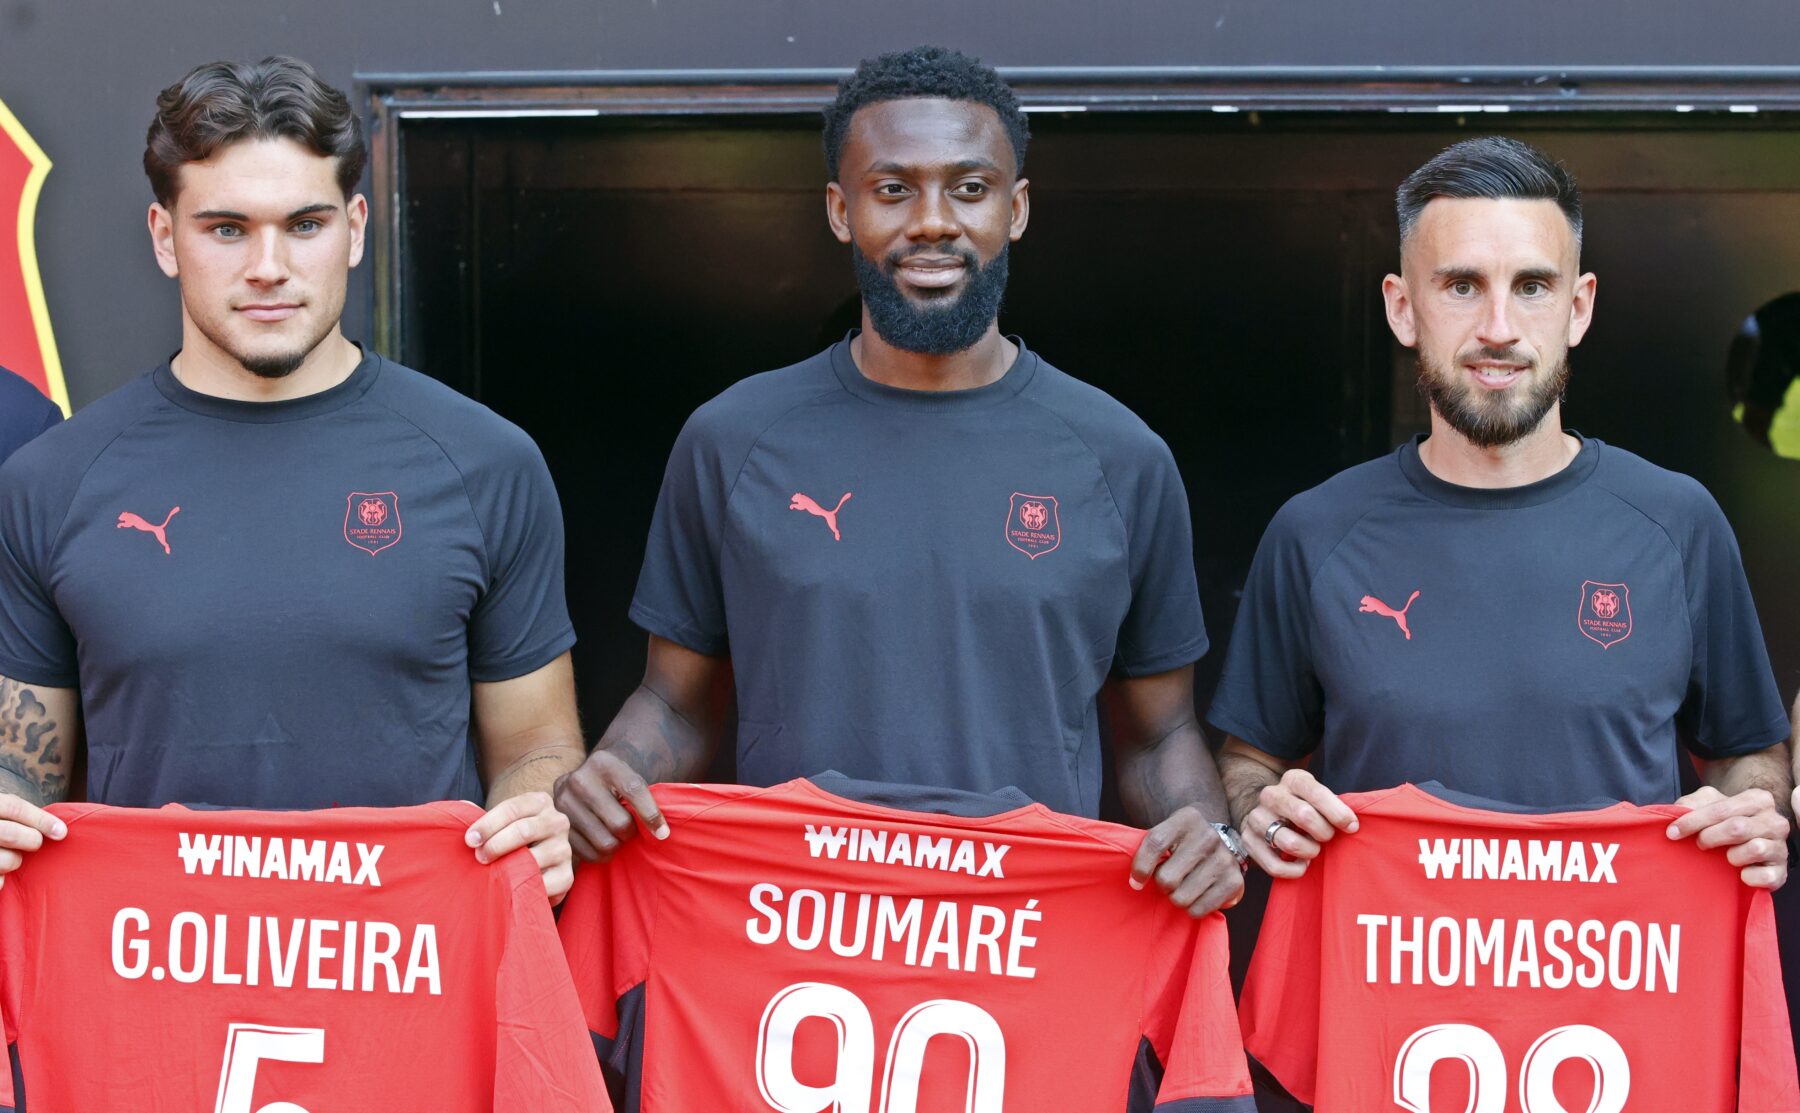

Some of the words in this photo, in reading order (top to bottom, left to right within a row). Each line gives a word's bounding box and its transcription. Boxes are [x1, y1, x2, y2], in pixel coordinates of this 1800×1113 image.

[1011, 530, 1030, 538] STADE
[1030, 532, 1056, 541] RENNAIS
[1583, 619, 1602, 627] STADE
[1602, 621, 1628, 629] RENNAIS
[178, 832, 385, 887] WINAMAX
[805, 824, 1011, 878] WINAMAX
[1418, 838, 1620, 884] WINAMAX
[111, 907, 442, 995] G.OLIVEIRA
[745, 882, 1043, 979] SOUMARÉ
[1356, 913, 1681, 994] THOMASSON
